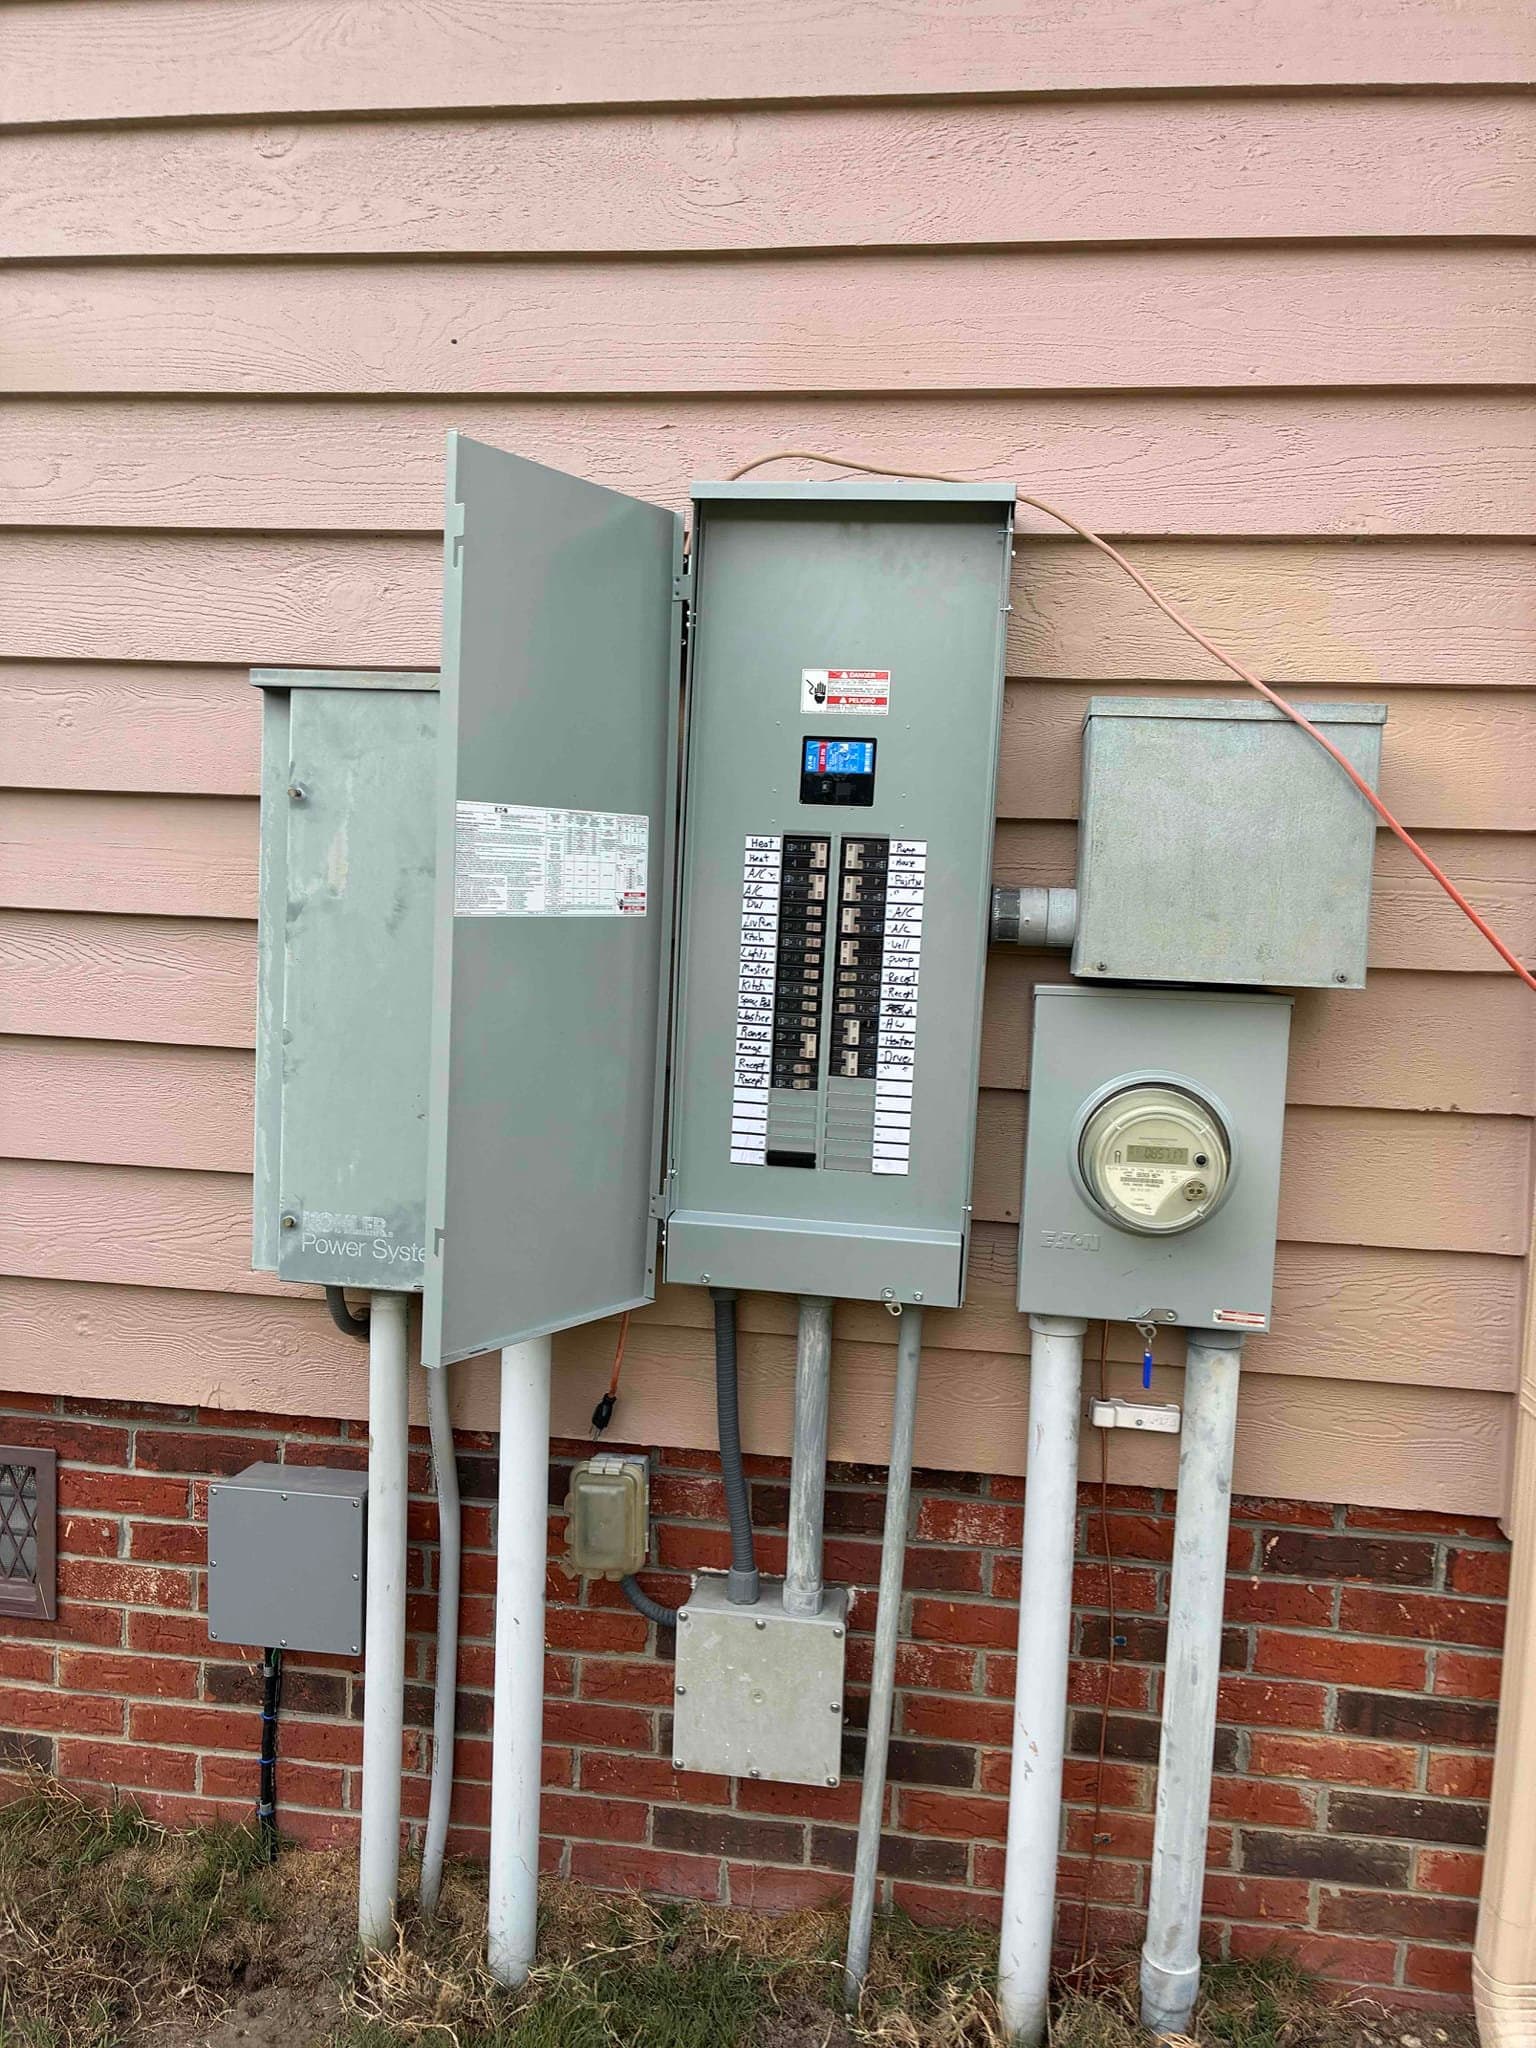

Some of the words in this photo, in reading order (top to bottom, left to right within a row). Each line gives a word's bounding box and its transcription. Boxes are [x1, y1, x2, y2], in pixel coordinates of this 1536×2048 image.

[751, 837, 774, 848] Heat
[892, 906, 915, 918] A/C
[301, 1232, 367, 1257] Power
